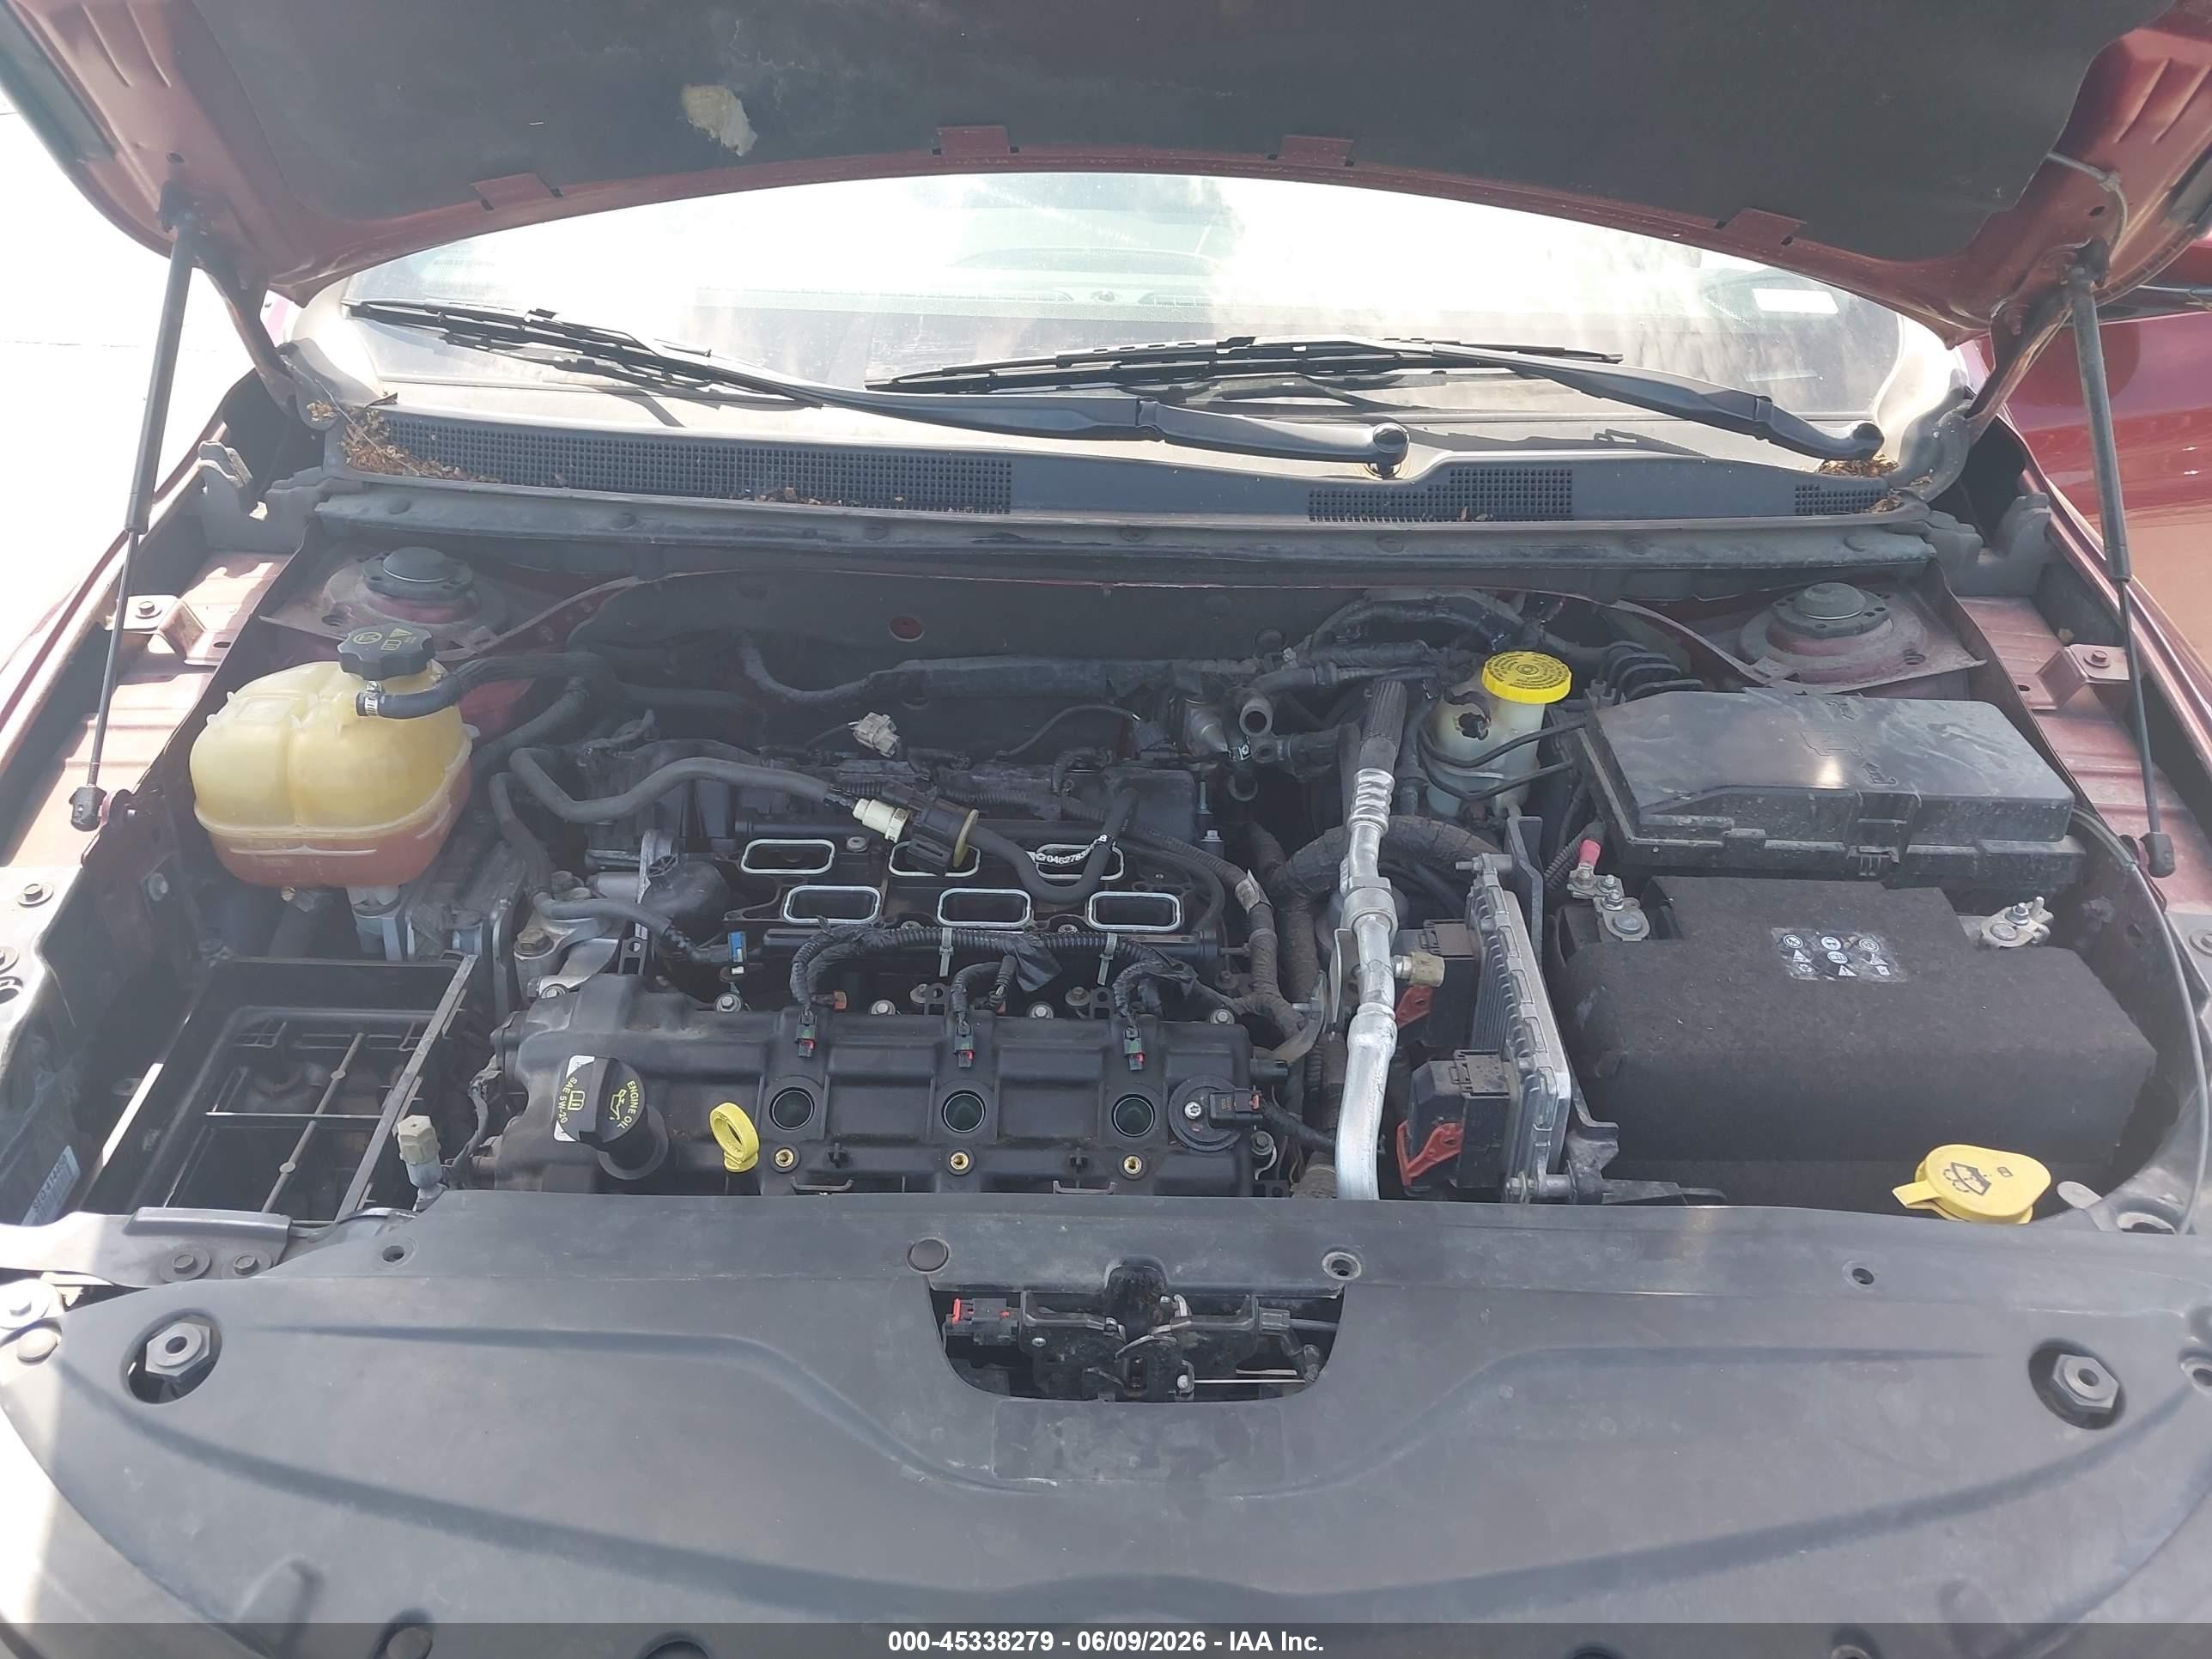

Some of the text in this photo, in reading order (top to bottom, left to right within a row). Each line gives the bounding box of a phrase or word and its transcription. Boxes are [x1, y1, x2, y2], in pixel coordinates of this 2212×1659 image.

[557, 1077, 578, 1124] SAE 5W-20
[617, 1080, 640, 1130] ENGINE OIL
